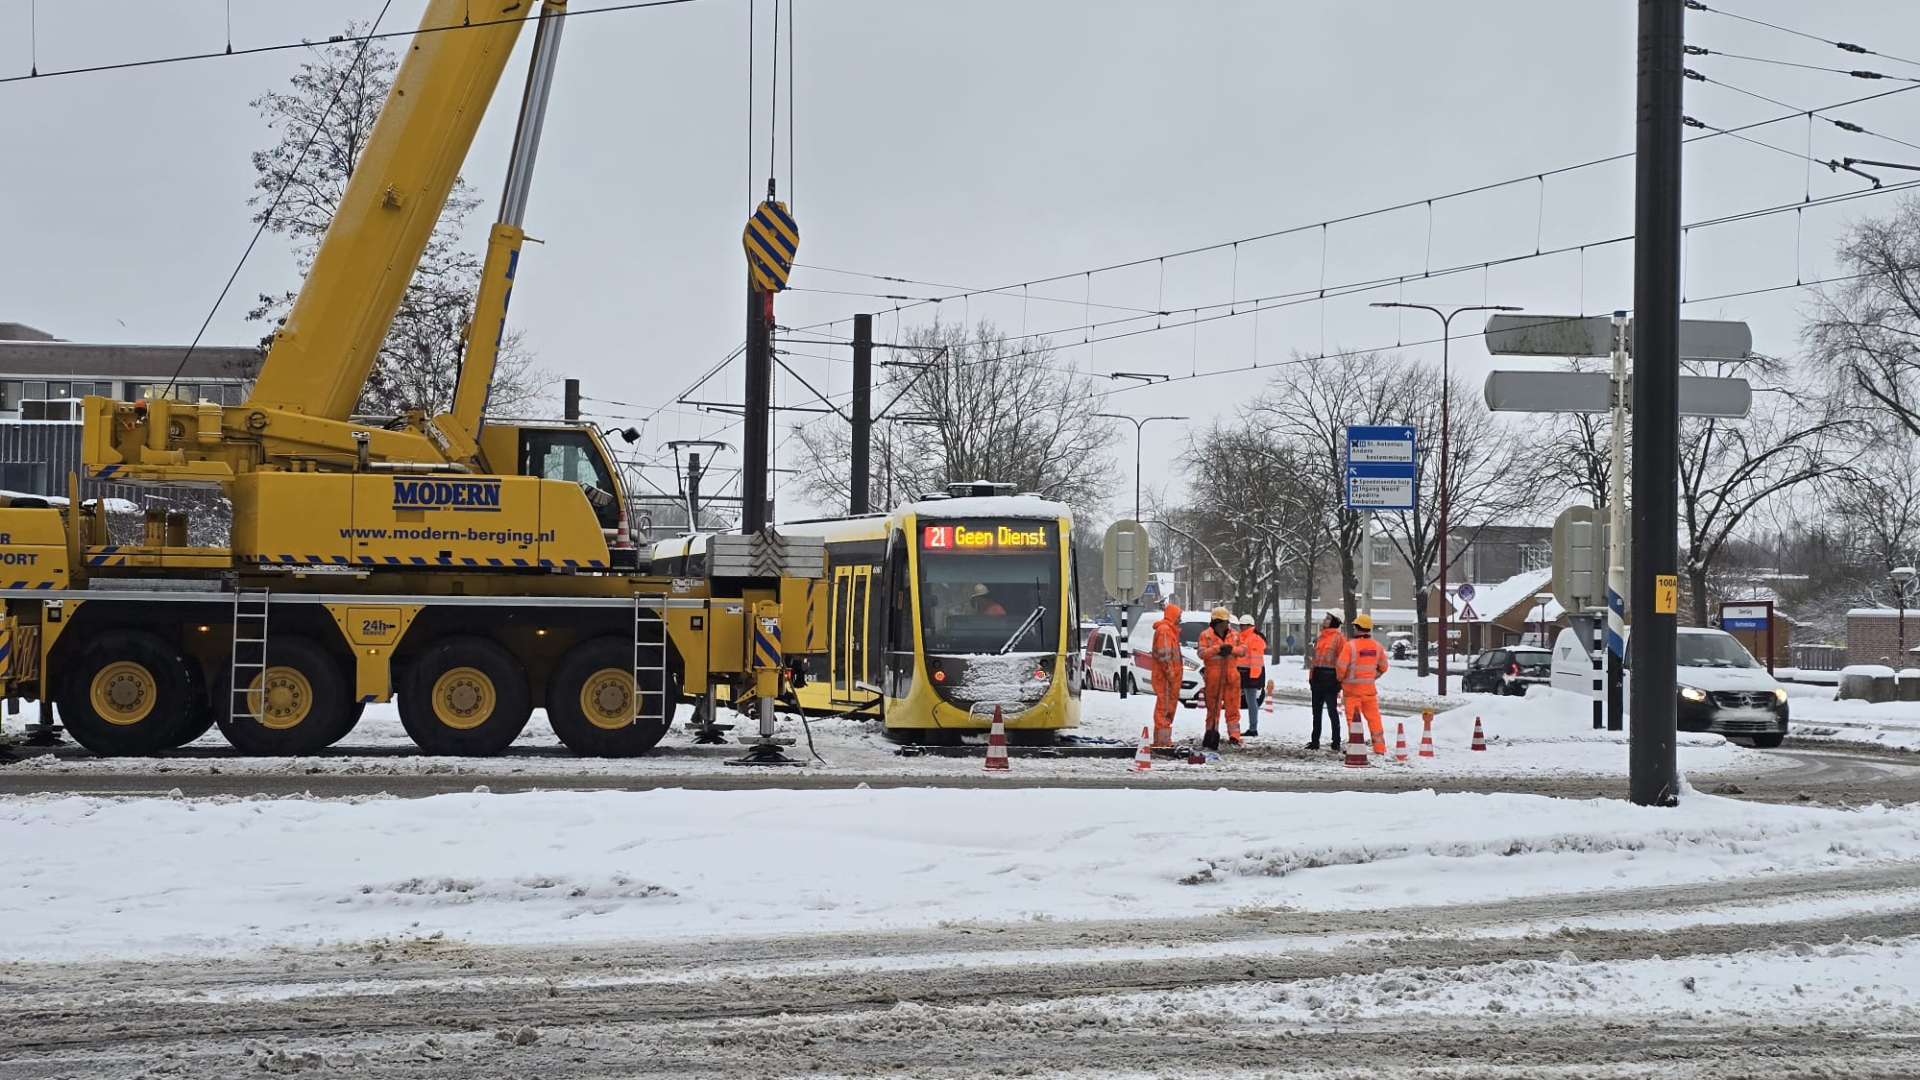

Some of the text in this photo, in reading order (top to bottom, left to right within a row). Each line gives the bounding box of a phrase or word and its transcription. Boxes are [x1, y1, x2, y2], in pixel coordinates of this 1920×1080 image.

[393, 482, 501, 506] MODERN
[339, 526, 555, 545] www.modern-berging.nl
[931, 526, 1047, 547] 21 Geen Dienst
[1658, 579, 1677, 587] 100A
[362, 620, 387, 631] 24h
